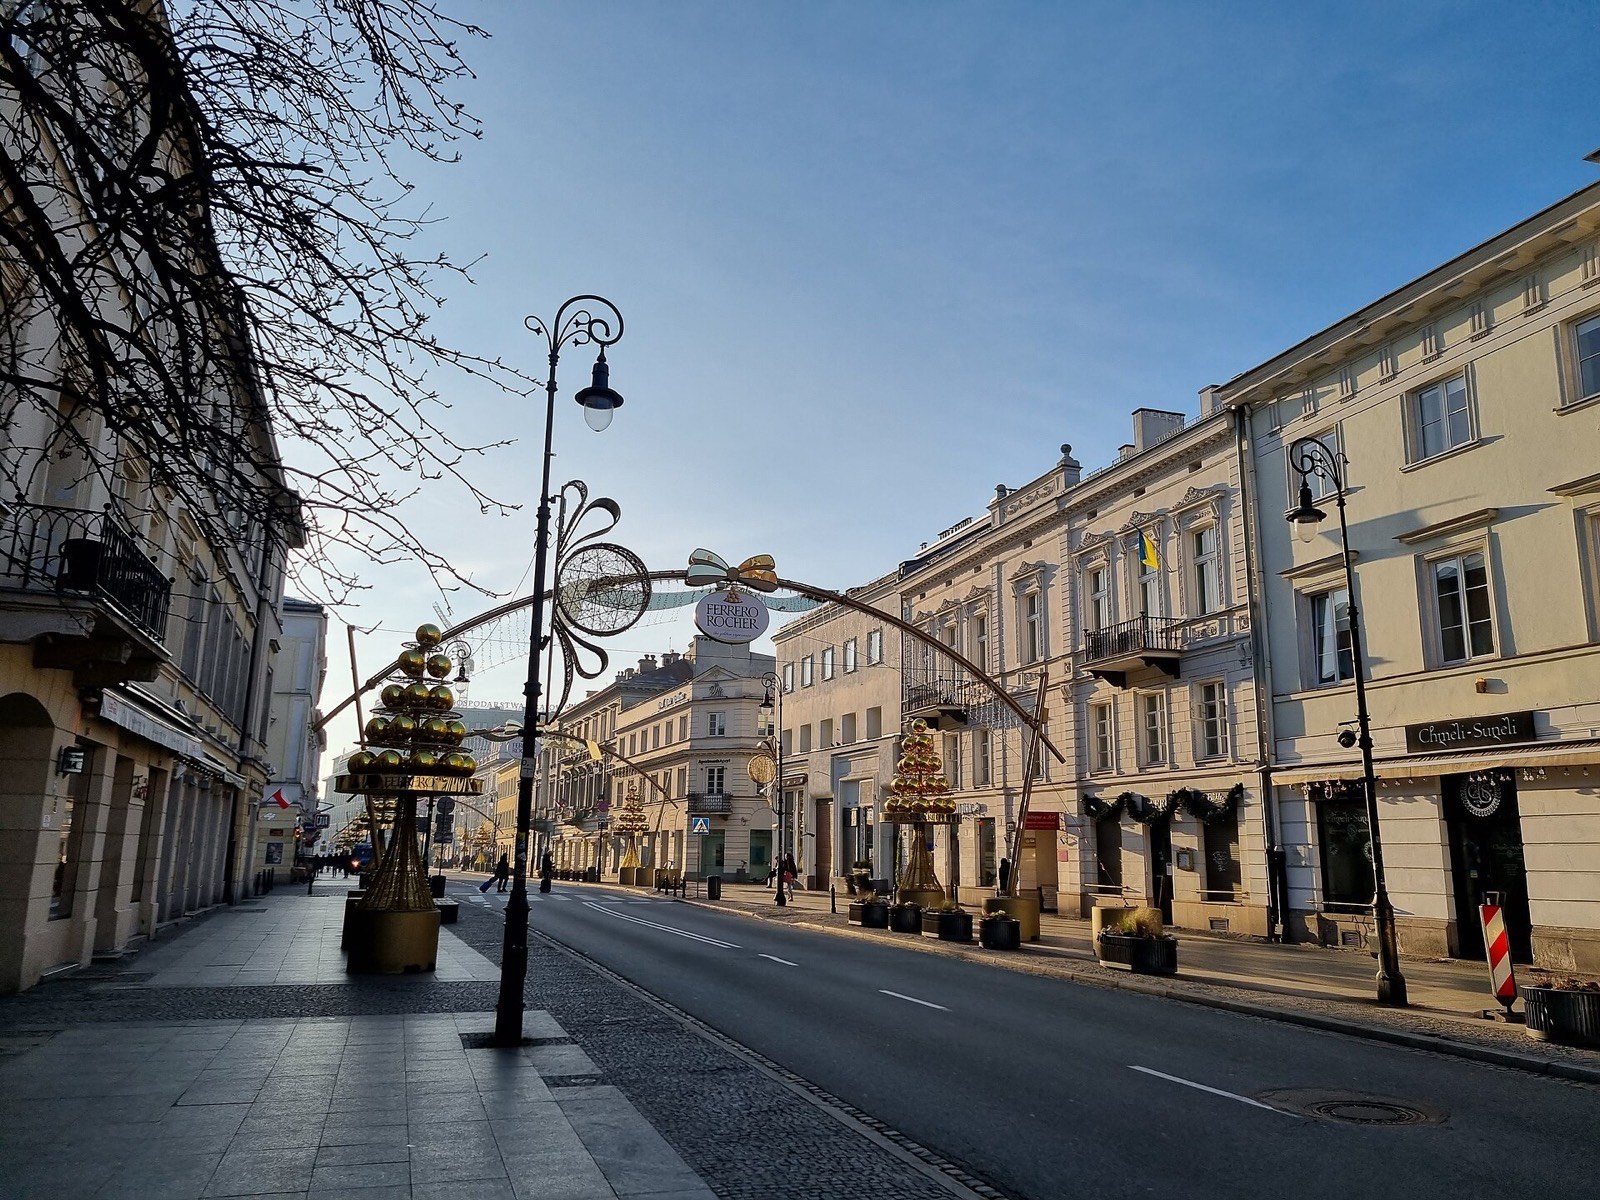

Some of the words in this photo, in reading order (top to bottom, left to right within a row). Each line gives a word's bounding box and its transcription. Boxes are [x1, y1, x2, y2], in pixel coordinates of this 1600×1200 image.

[706, 603, 759, 618] FERRERO
[706, 615, 759, 630] ROCHER
[454, 700, 524, 710] OSPODARSTWA
[1418, 716, 1518, 747] Chmeli-Suneli
